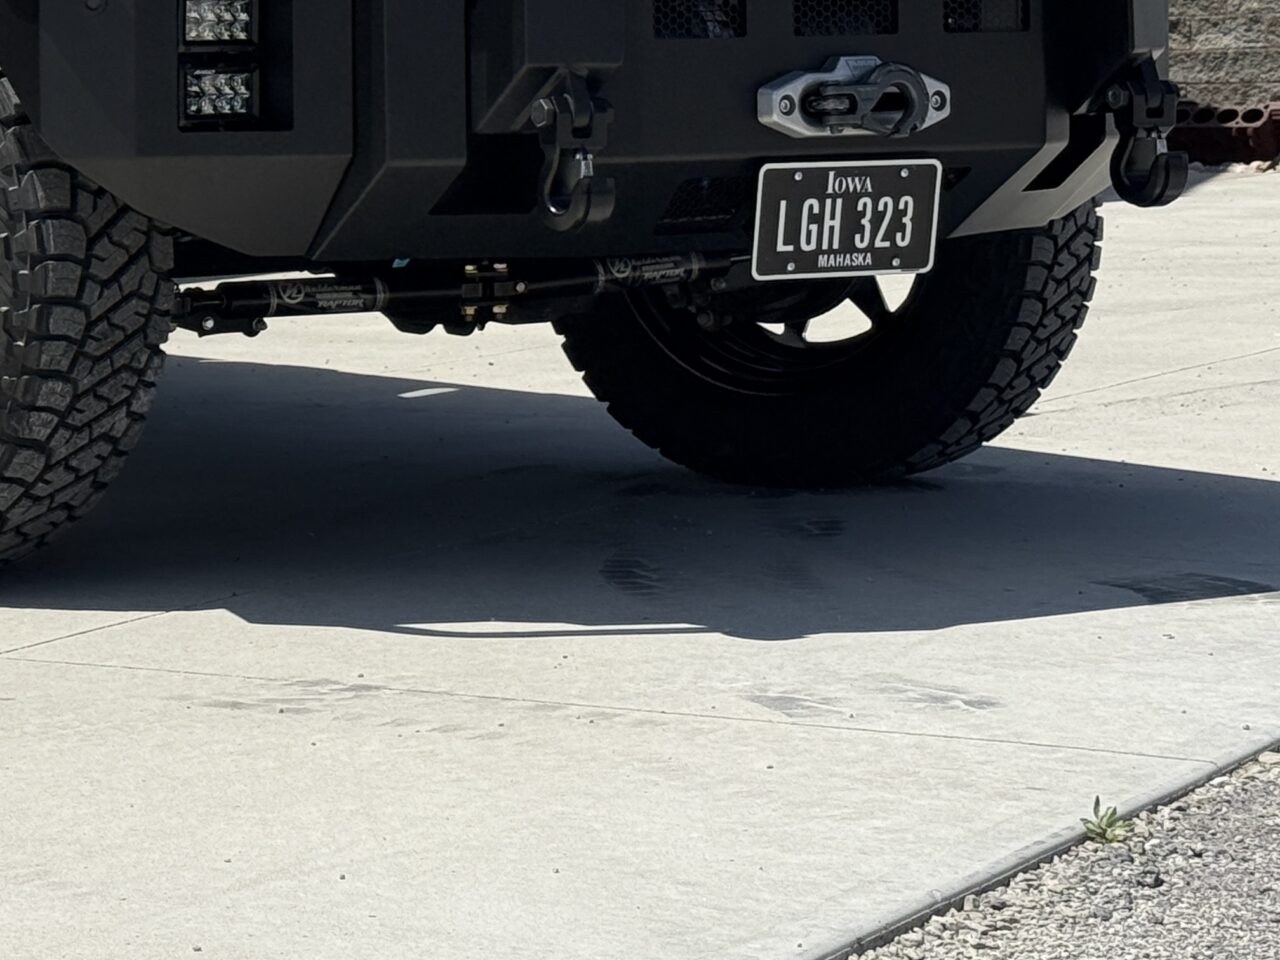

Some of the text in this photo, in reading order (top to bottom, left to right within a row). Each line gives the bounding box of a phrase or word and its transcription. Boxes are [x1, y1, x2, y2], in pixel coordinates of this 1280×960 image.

[776, 195, 914, 252] LGH 323
[817, 252, 873, 268] MAHASKA
